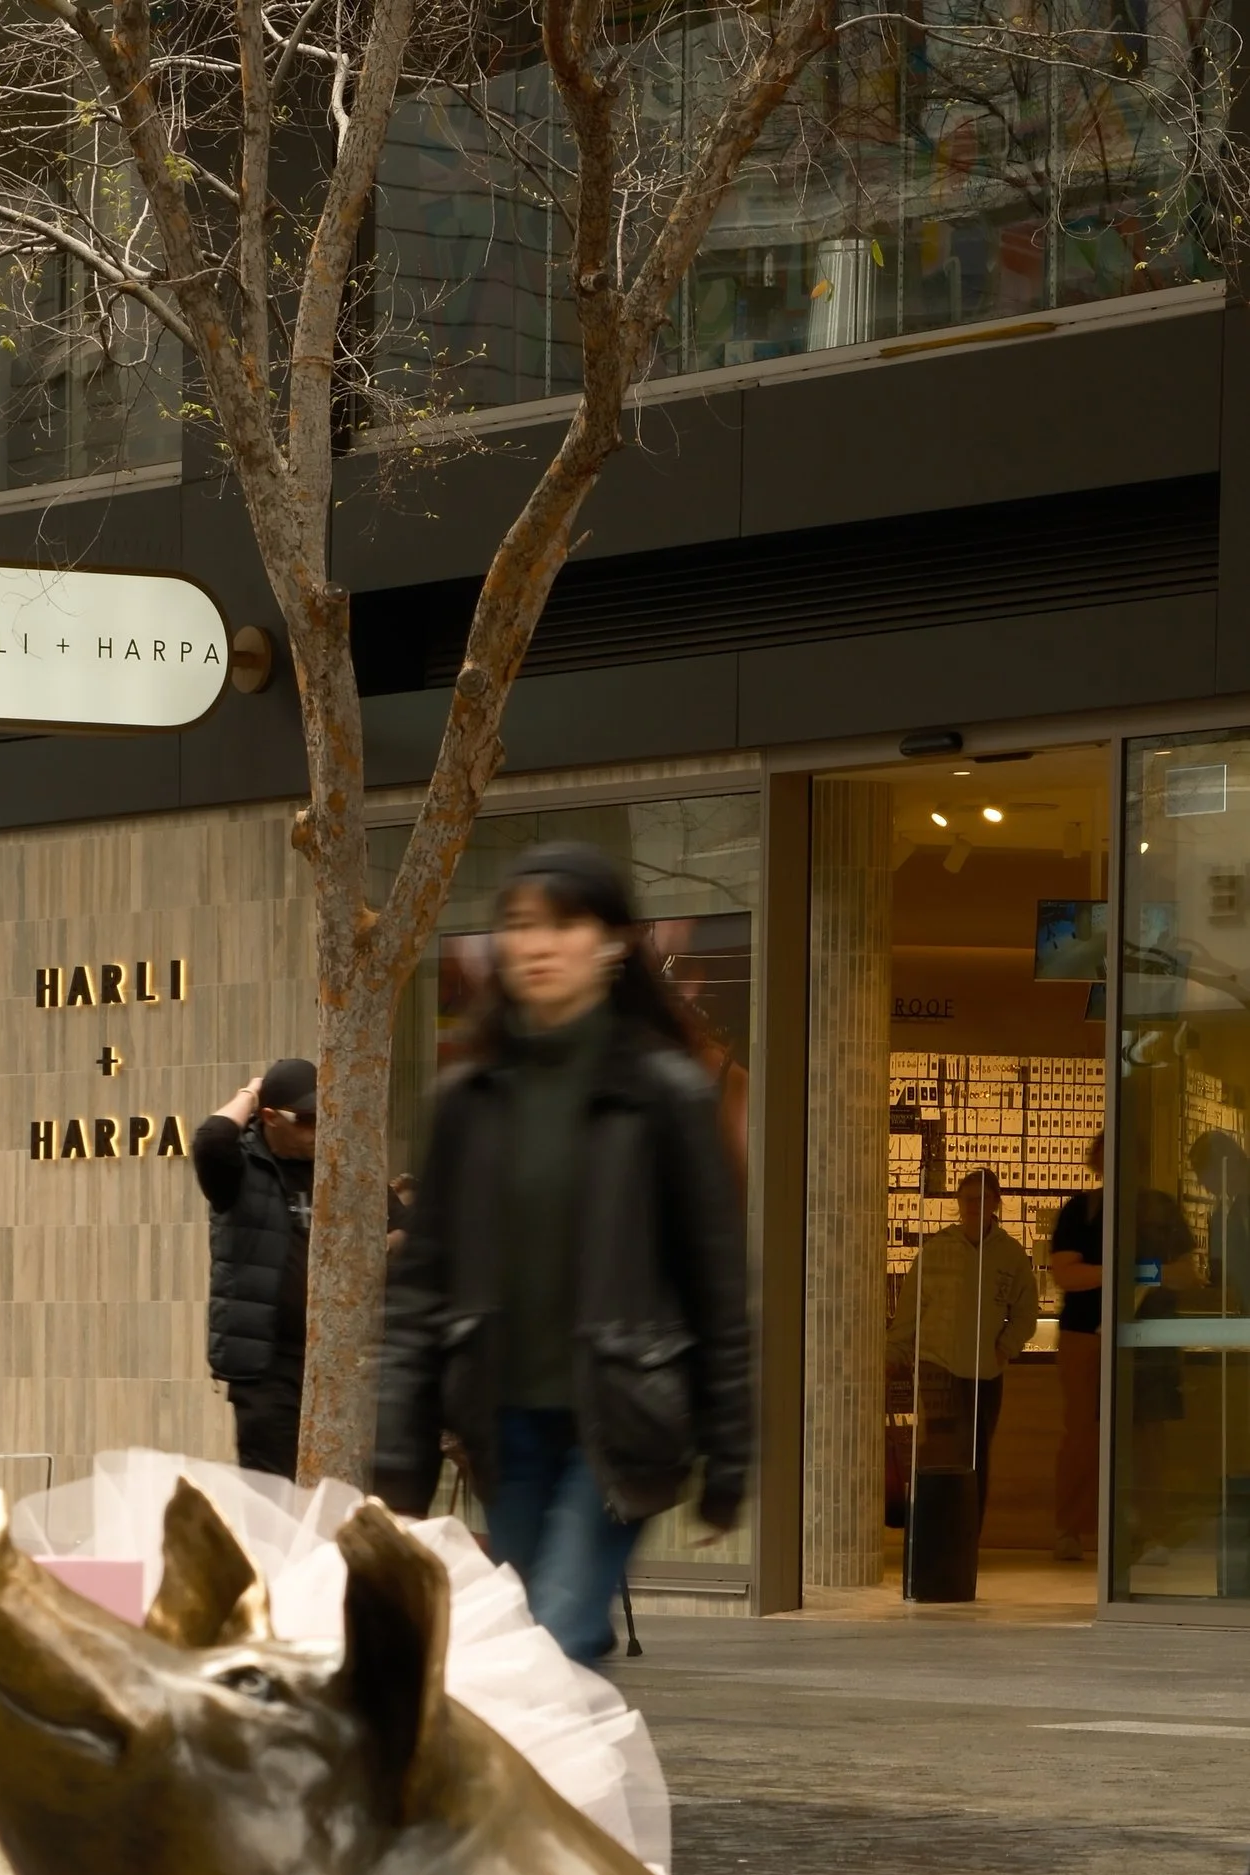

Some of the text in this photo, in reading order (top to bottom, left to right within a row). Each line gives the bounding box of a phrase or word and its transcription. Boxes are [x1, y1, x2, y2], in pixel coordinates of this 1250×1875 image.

[56, 638, 70, 653] +
[98, 637, 221, 665] HARPA
[36, 960, 184, 1008] HARLI
[96, 1047, 121, 1076] +
[31, 1116, 187, 1160] HARPA
